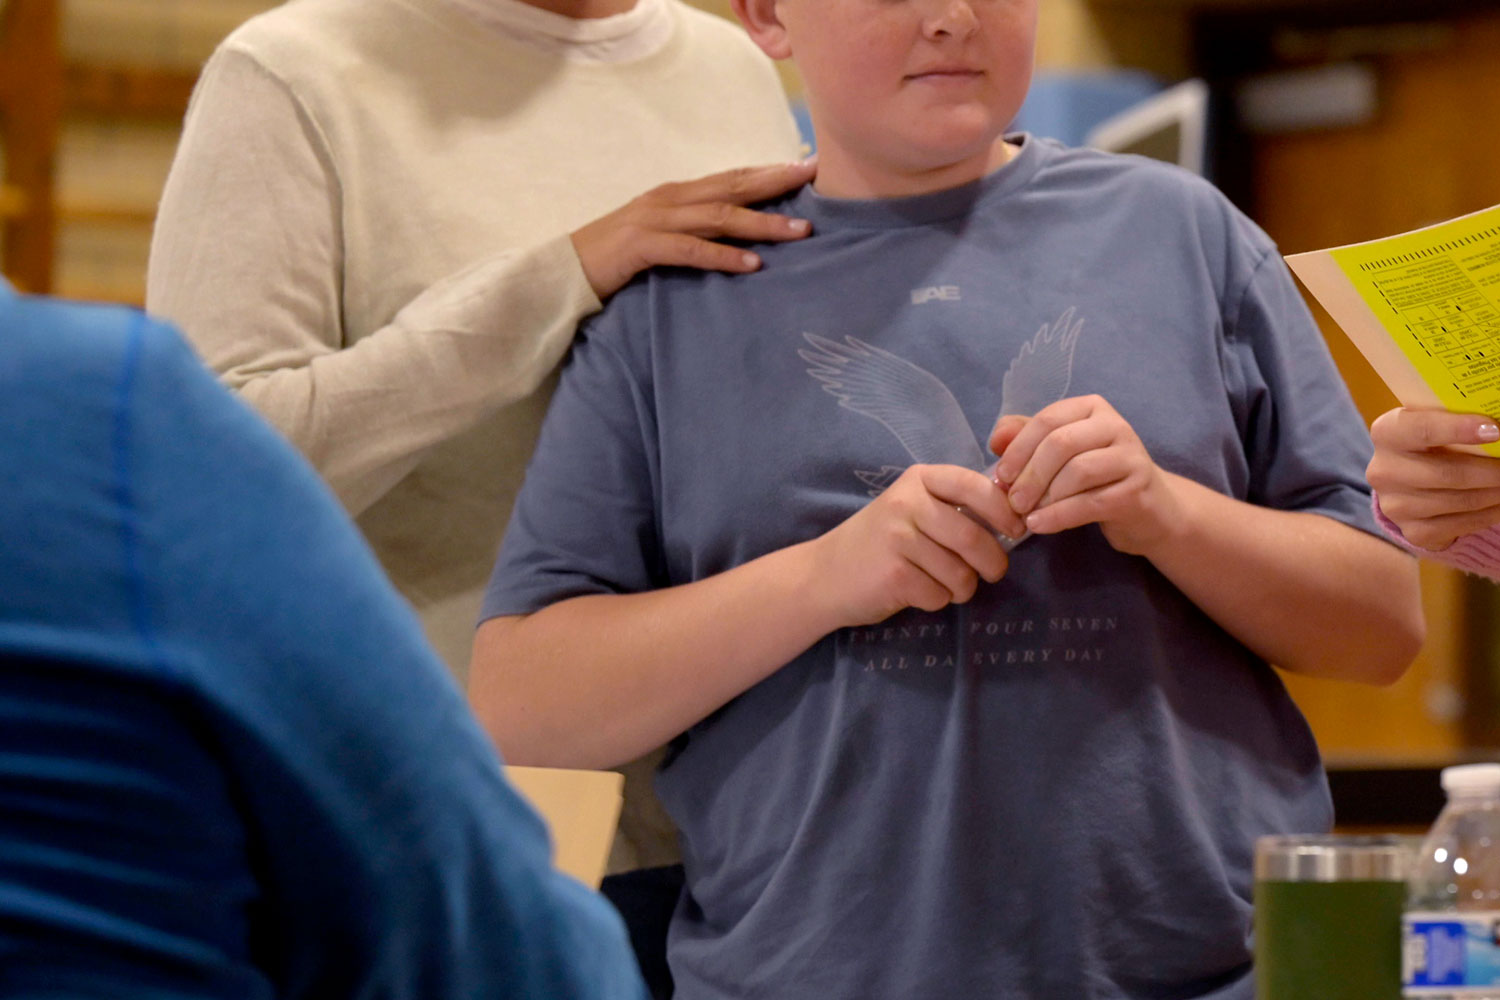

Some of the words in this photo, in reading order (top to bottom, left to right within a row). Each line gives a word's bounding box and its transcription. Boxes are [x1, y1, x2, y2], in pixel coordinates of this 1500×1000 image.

[1470, 367, 1488, 375] Escrito
[970, 618, 1034, 637] FOUR
[1048, 615, 1120, 632] SEVEN
[863, 656, 910, 673] ALL
[973, 648, 1053, 666] EVERY
[1064, 648, 1106, 662] DAY
